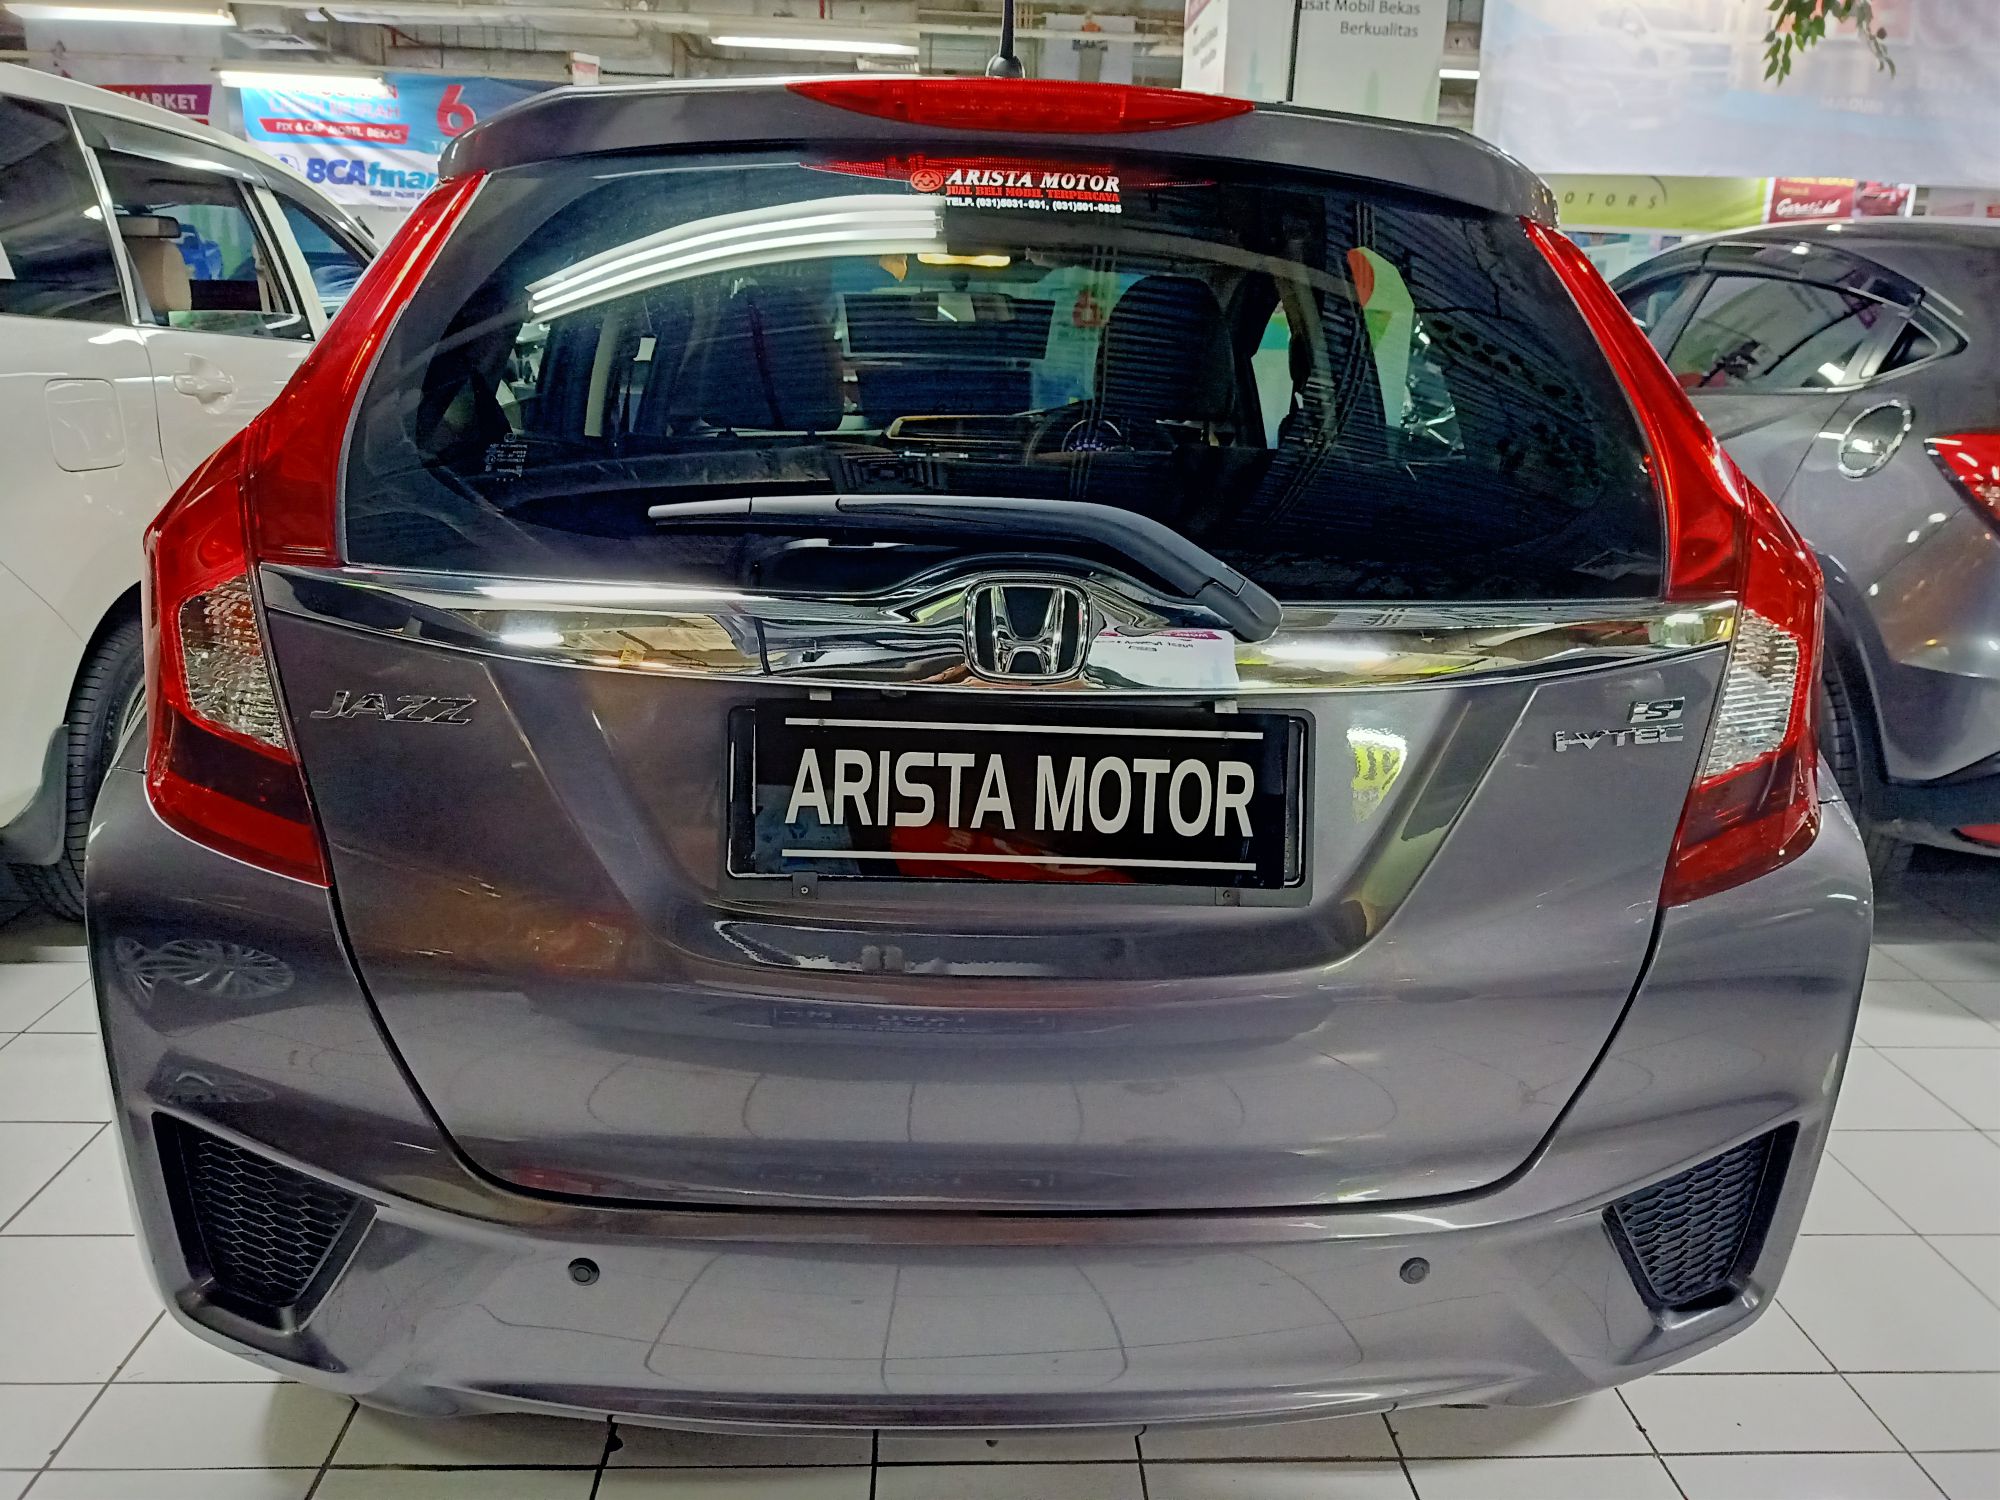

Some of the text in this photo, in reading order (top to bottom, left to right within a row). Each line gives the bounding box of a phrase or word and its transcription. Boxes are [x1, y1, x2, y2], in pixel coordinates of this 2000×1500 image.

[1299, 0, 1421, 15] usat Mobil Bekas
[1340, 21, 1418, 37] Berkualitas
[437, 84, 476, 137] 6
[945, 168, 1121, 193] ARISTA MOTOR
[310, 690, 477, 724] JAZZ
[785, 748, 1256, 838] ARISTA MOTOR
